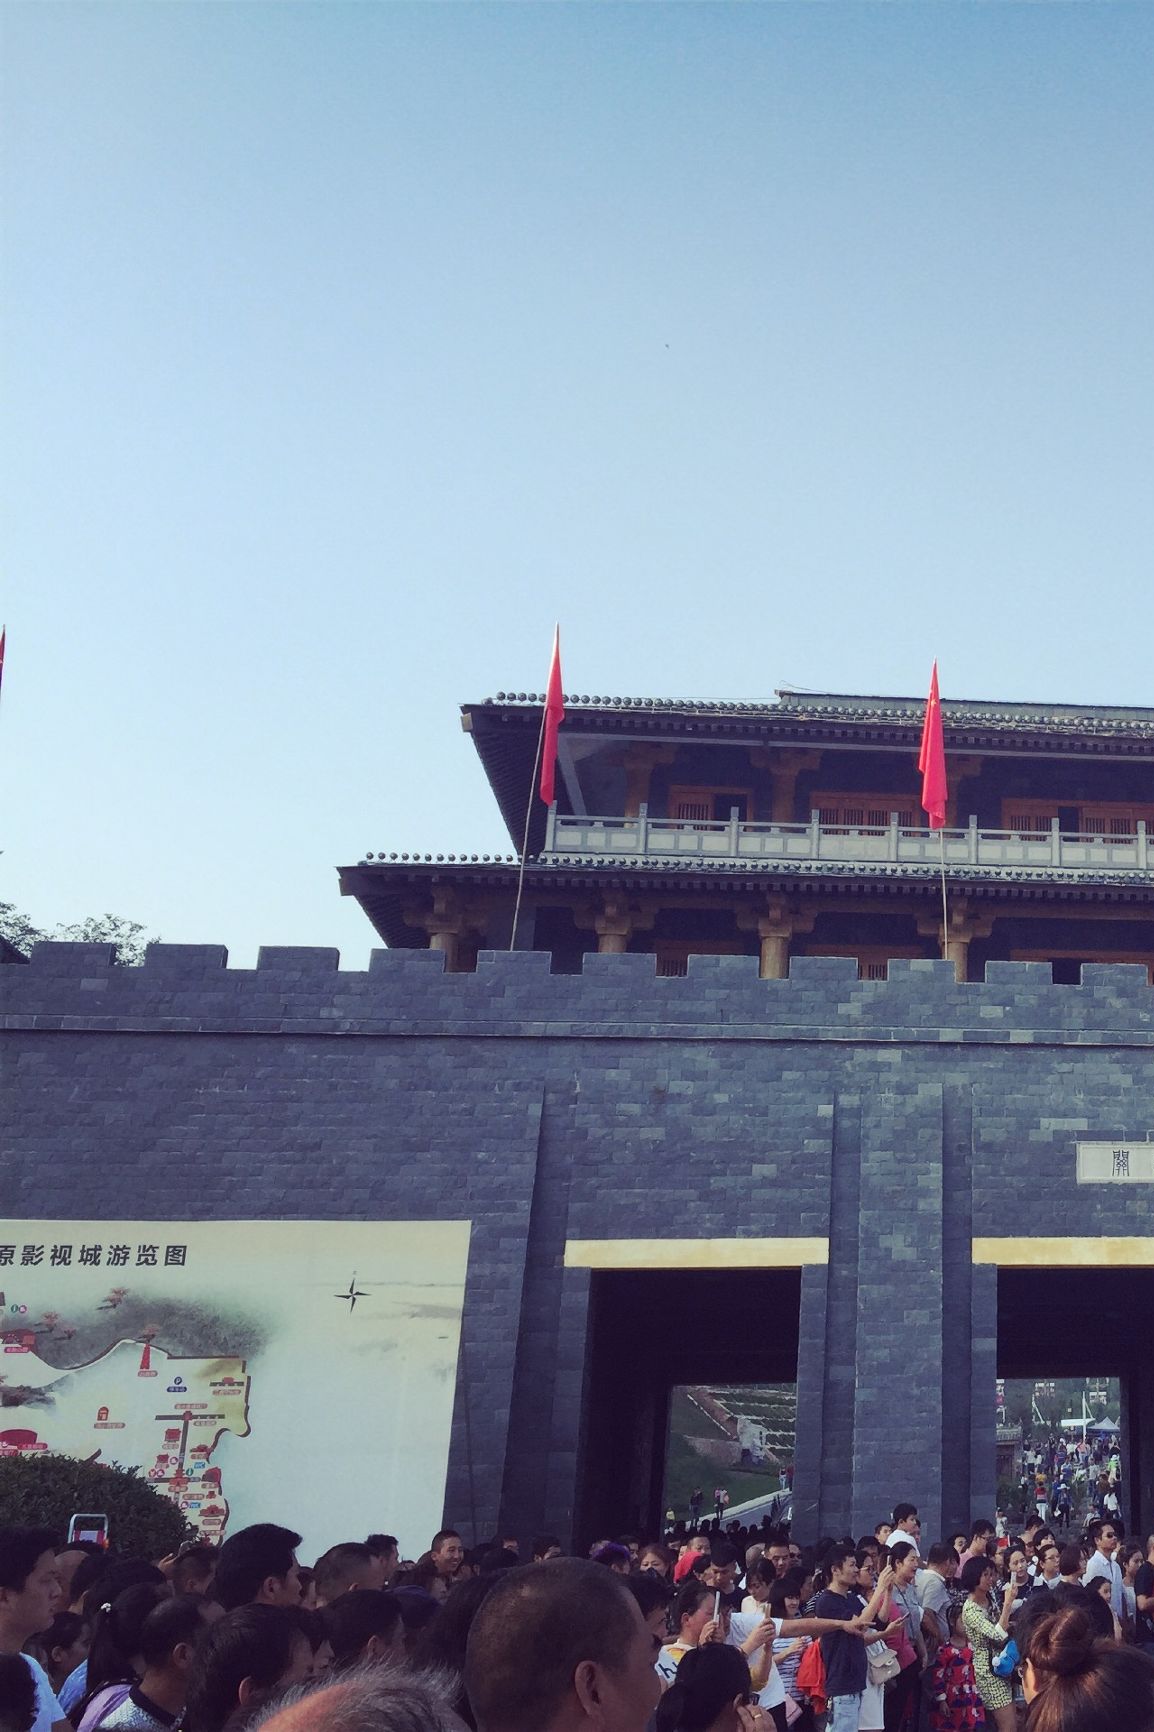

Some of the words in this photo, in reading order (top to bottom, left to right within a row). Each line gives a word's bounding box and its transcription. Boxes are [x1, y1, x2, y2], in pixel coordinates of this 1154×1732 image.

[0, 1245, 187, 1266] 原影视城游览图
